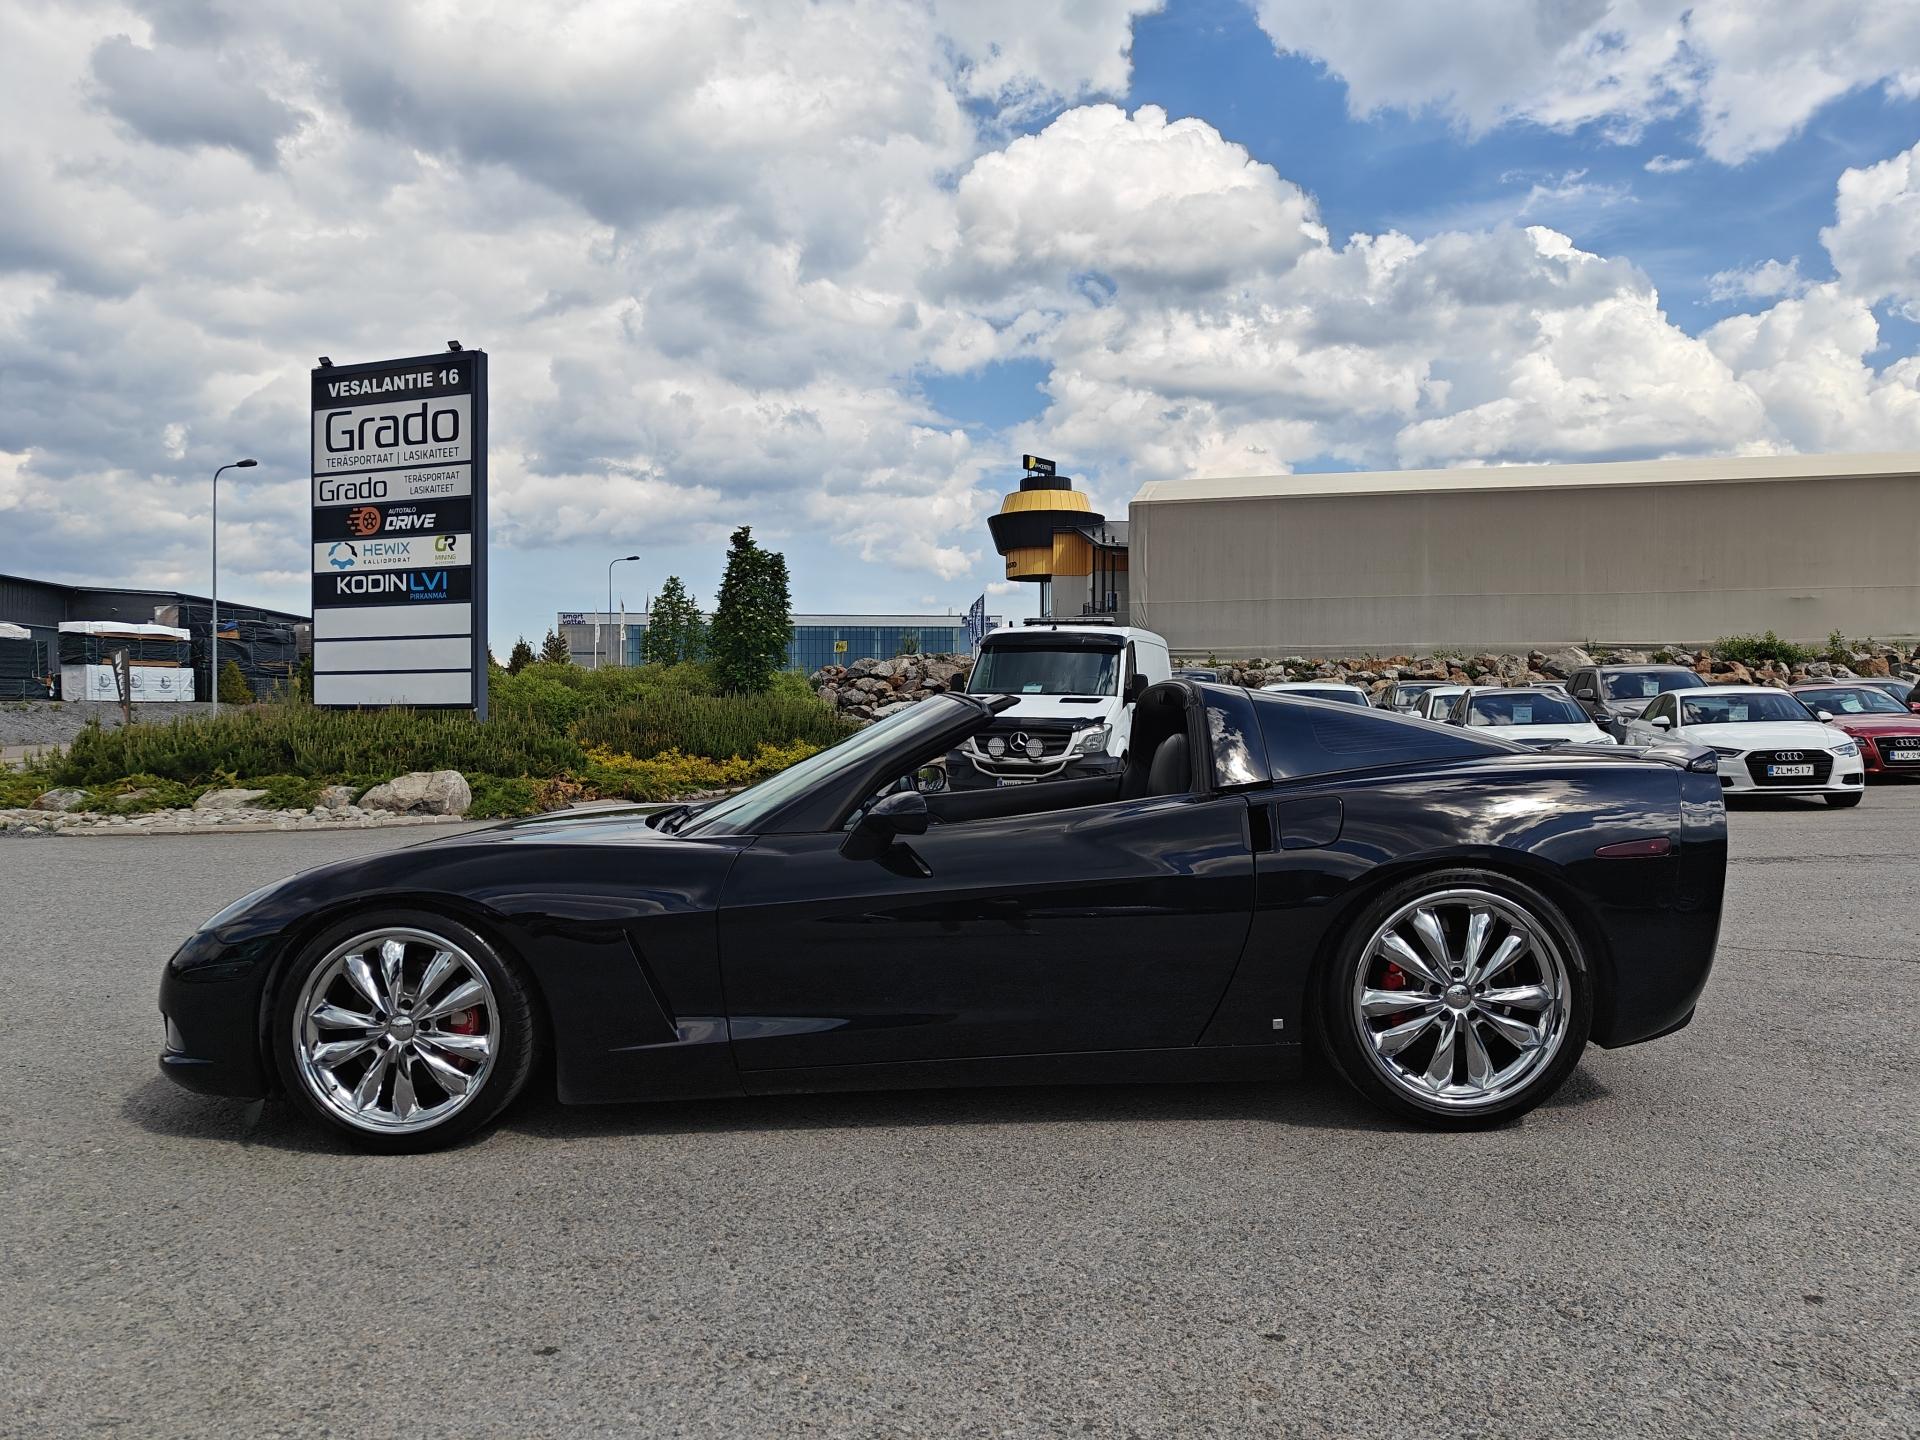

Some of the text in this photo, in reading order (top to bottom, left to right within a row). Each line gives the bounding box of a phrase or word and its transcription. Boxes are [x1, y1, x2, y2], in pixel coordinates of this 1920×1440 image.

[327, 368, 459, 398] VESALANTIE 16
[325, 402, 459, 453] Grado
[326, 446, 460, 468] TERÄSPORTAAT LASIKAITEET
[404, 470, 460, 484] TERÄSPORTAAT
[319, 476, 388, 502] Grado
[409, 483, 454, 495] LASIKAITEET
[388, 506, 417, 514] AUTOTALO
[384, 513, 437, 531] DRIVE
[363, 541, 411, 557] HEWIX
[434, 535, 457, 552] GR
[363, 557, 411, 565] KALLIOPORAT
[409, 592, 448, 601] PIRKANMAA
[1775, 766, 1811, 775] ZLM-517
